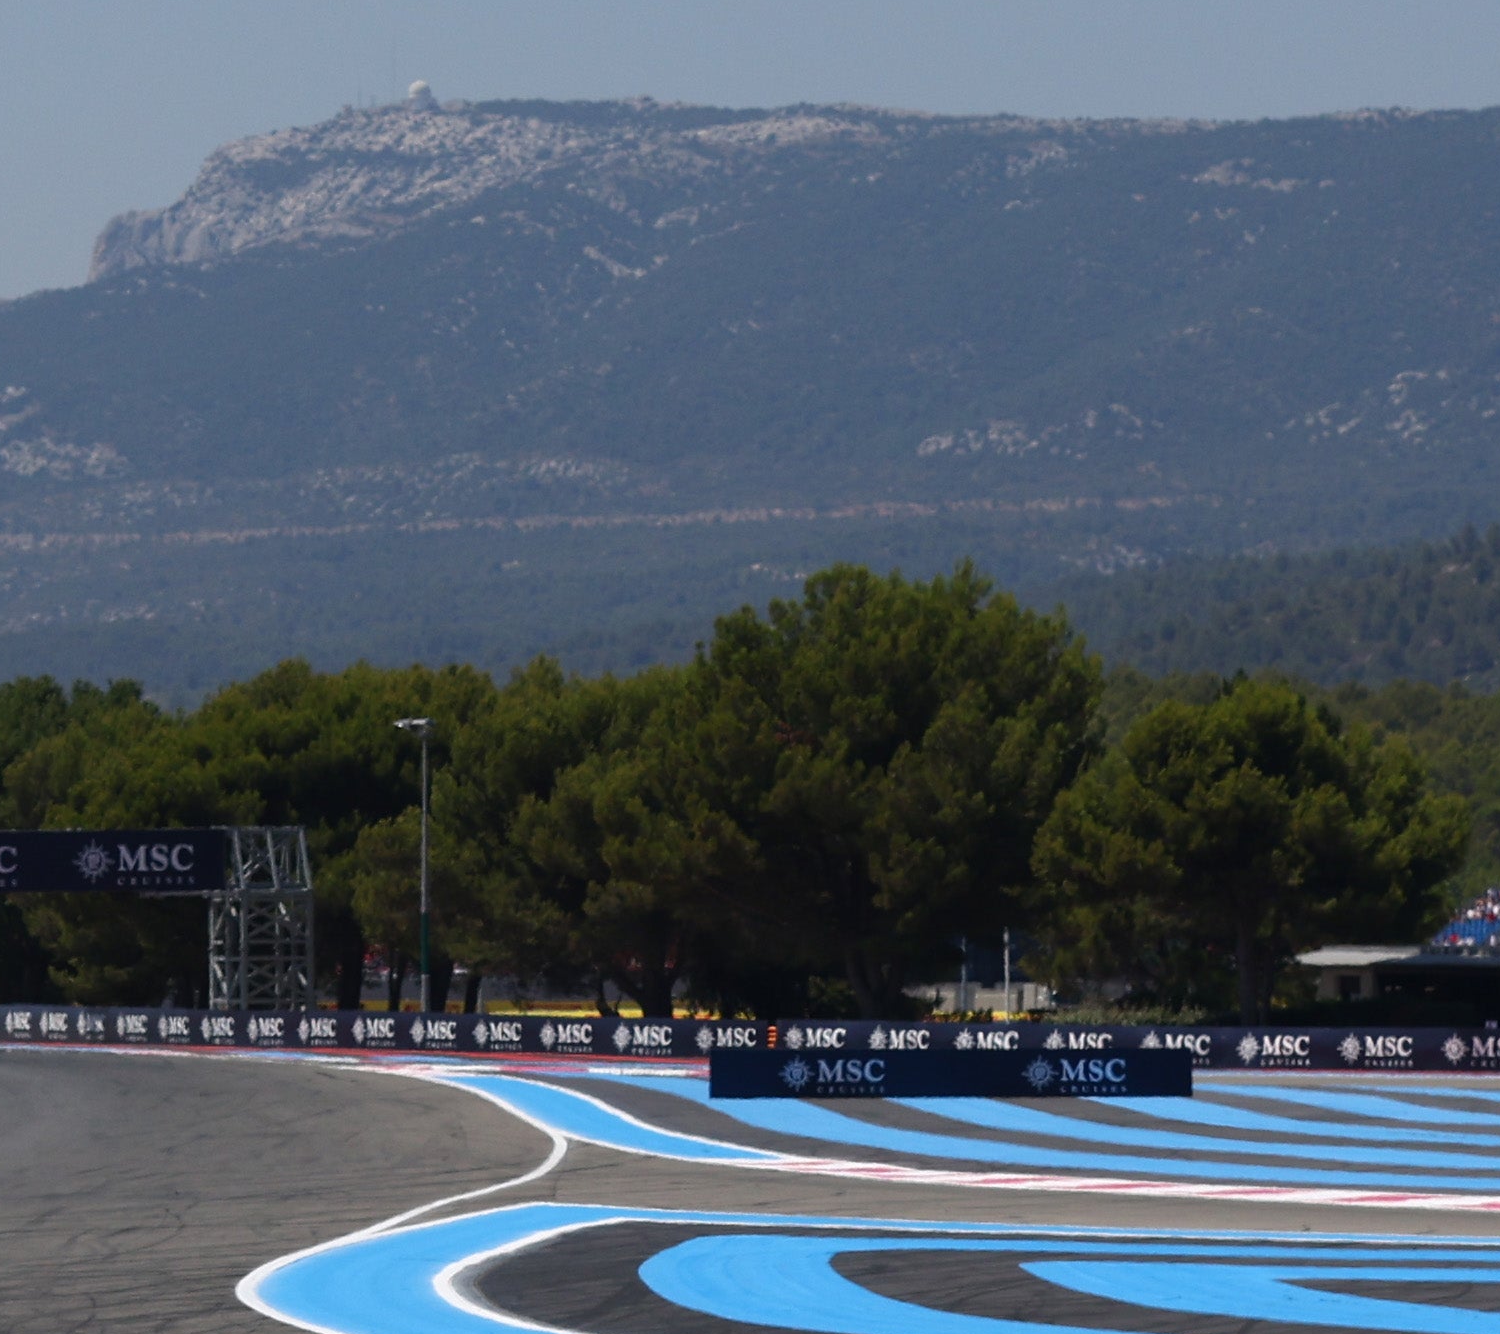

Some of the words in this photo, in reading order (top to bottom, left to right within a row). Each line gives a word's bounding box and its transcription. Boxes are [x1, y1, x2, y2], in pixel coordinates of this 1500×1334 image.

[118, 845, 193, 871] MSC
[311, 1018, 336, 1037] MSC
[364, 1019, 394, 1037] MSC
[424, 1020, 456, 1039] MSC
[487, 1022, 522, 1042] MSC
[558, 1024, 592, 1043] MSC
[633, 1026, 671, 1046] MSC
[717, 1028, 756, 1047] MSC
[806, 1028, 846, 1047] MSC
[889, 1030, 929, 1049] MSC
[1262, 1035, 1309, 1055] MSC
[1366, 1036, 1412, 1056] MSC
[818, 1060, 884, 1082] MSC
[1060, 1060, 1126, 1082] MSC
